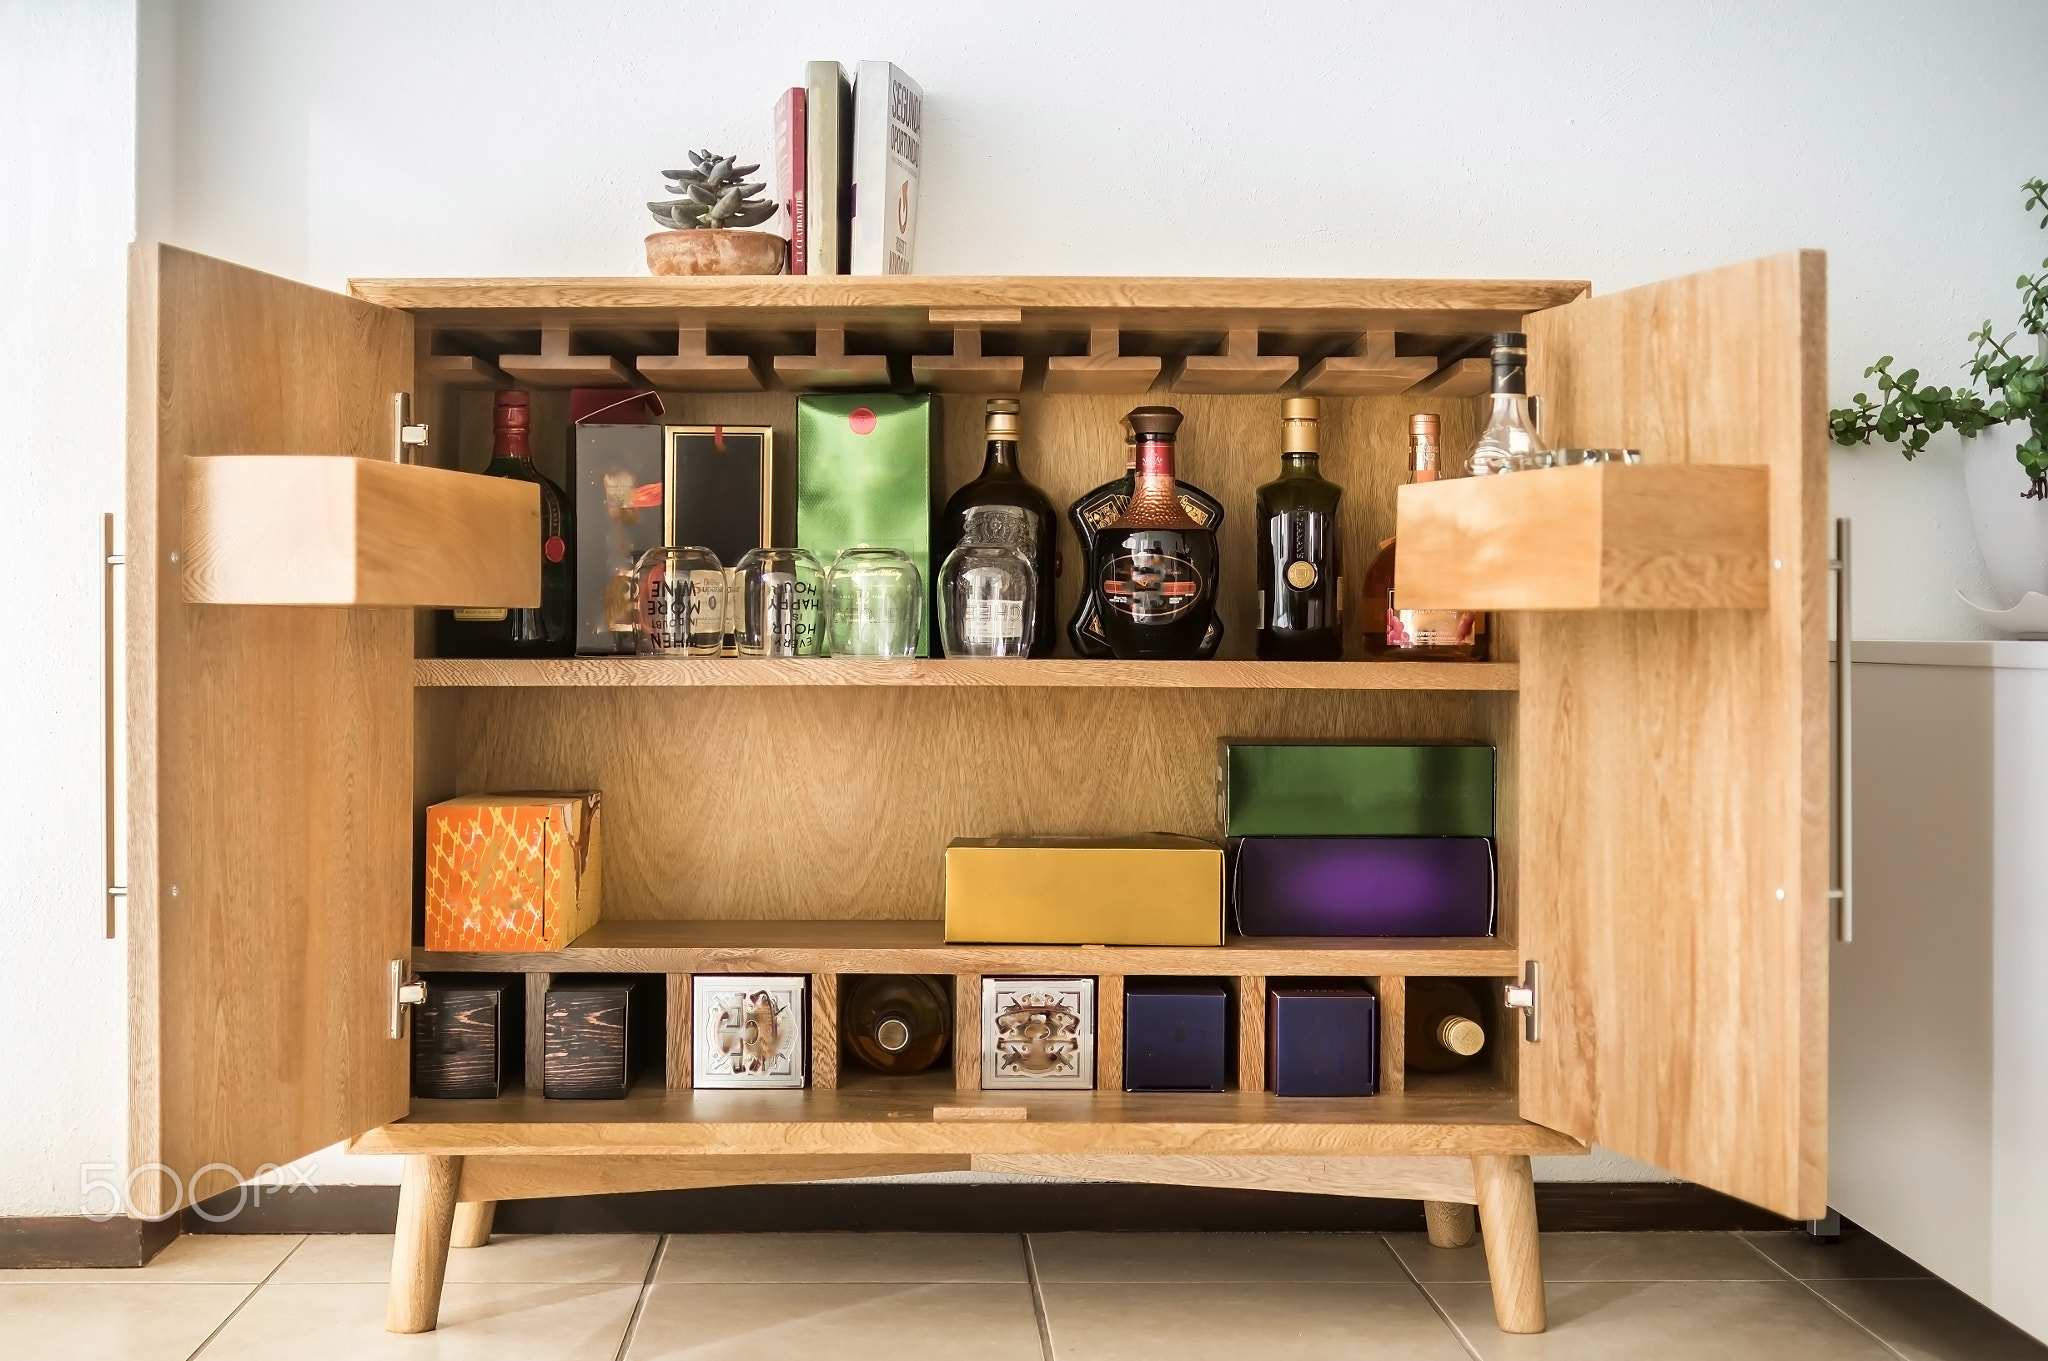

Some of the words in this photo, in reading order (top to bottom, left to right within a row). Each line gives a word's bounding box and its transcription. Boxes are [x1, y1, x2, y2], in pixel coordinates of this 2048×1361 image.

[651, 580, 697, 597] WINE
[772, 581, 817, 596] HOUR
[648, 600, 701, 615] MORE
[768, 599, 820, 610] HAPPY
[651, 618, 685, 629] DOUBT
[792, 613, 803, 621] IS
[773, 621, 817, 635] HOUR
[651, 633, 698, 648] WHEN
[775, 636, 812, 648] EVERY
